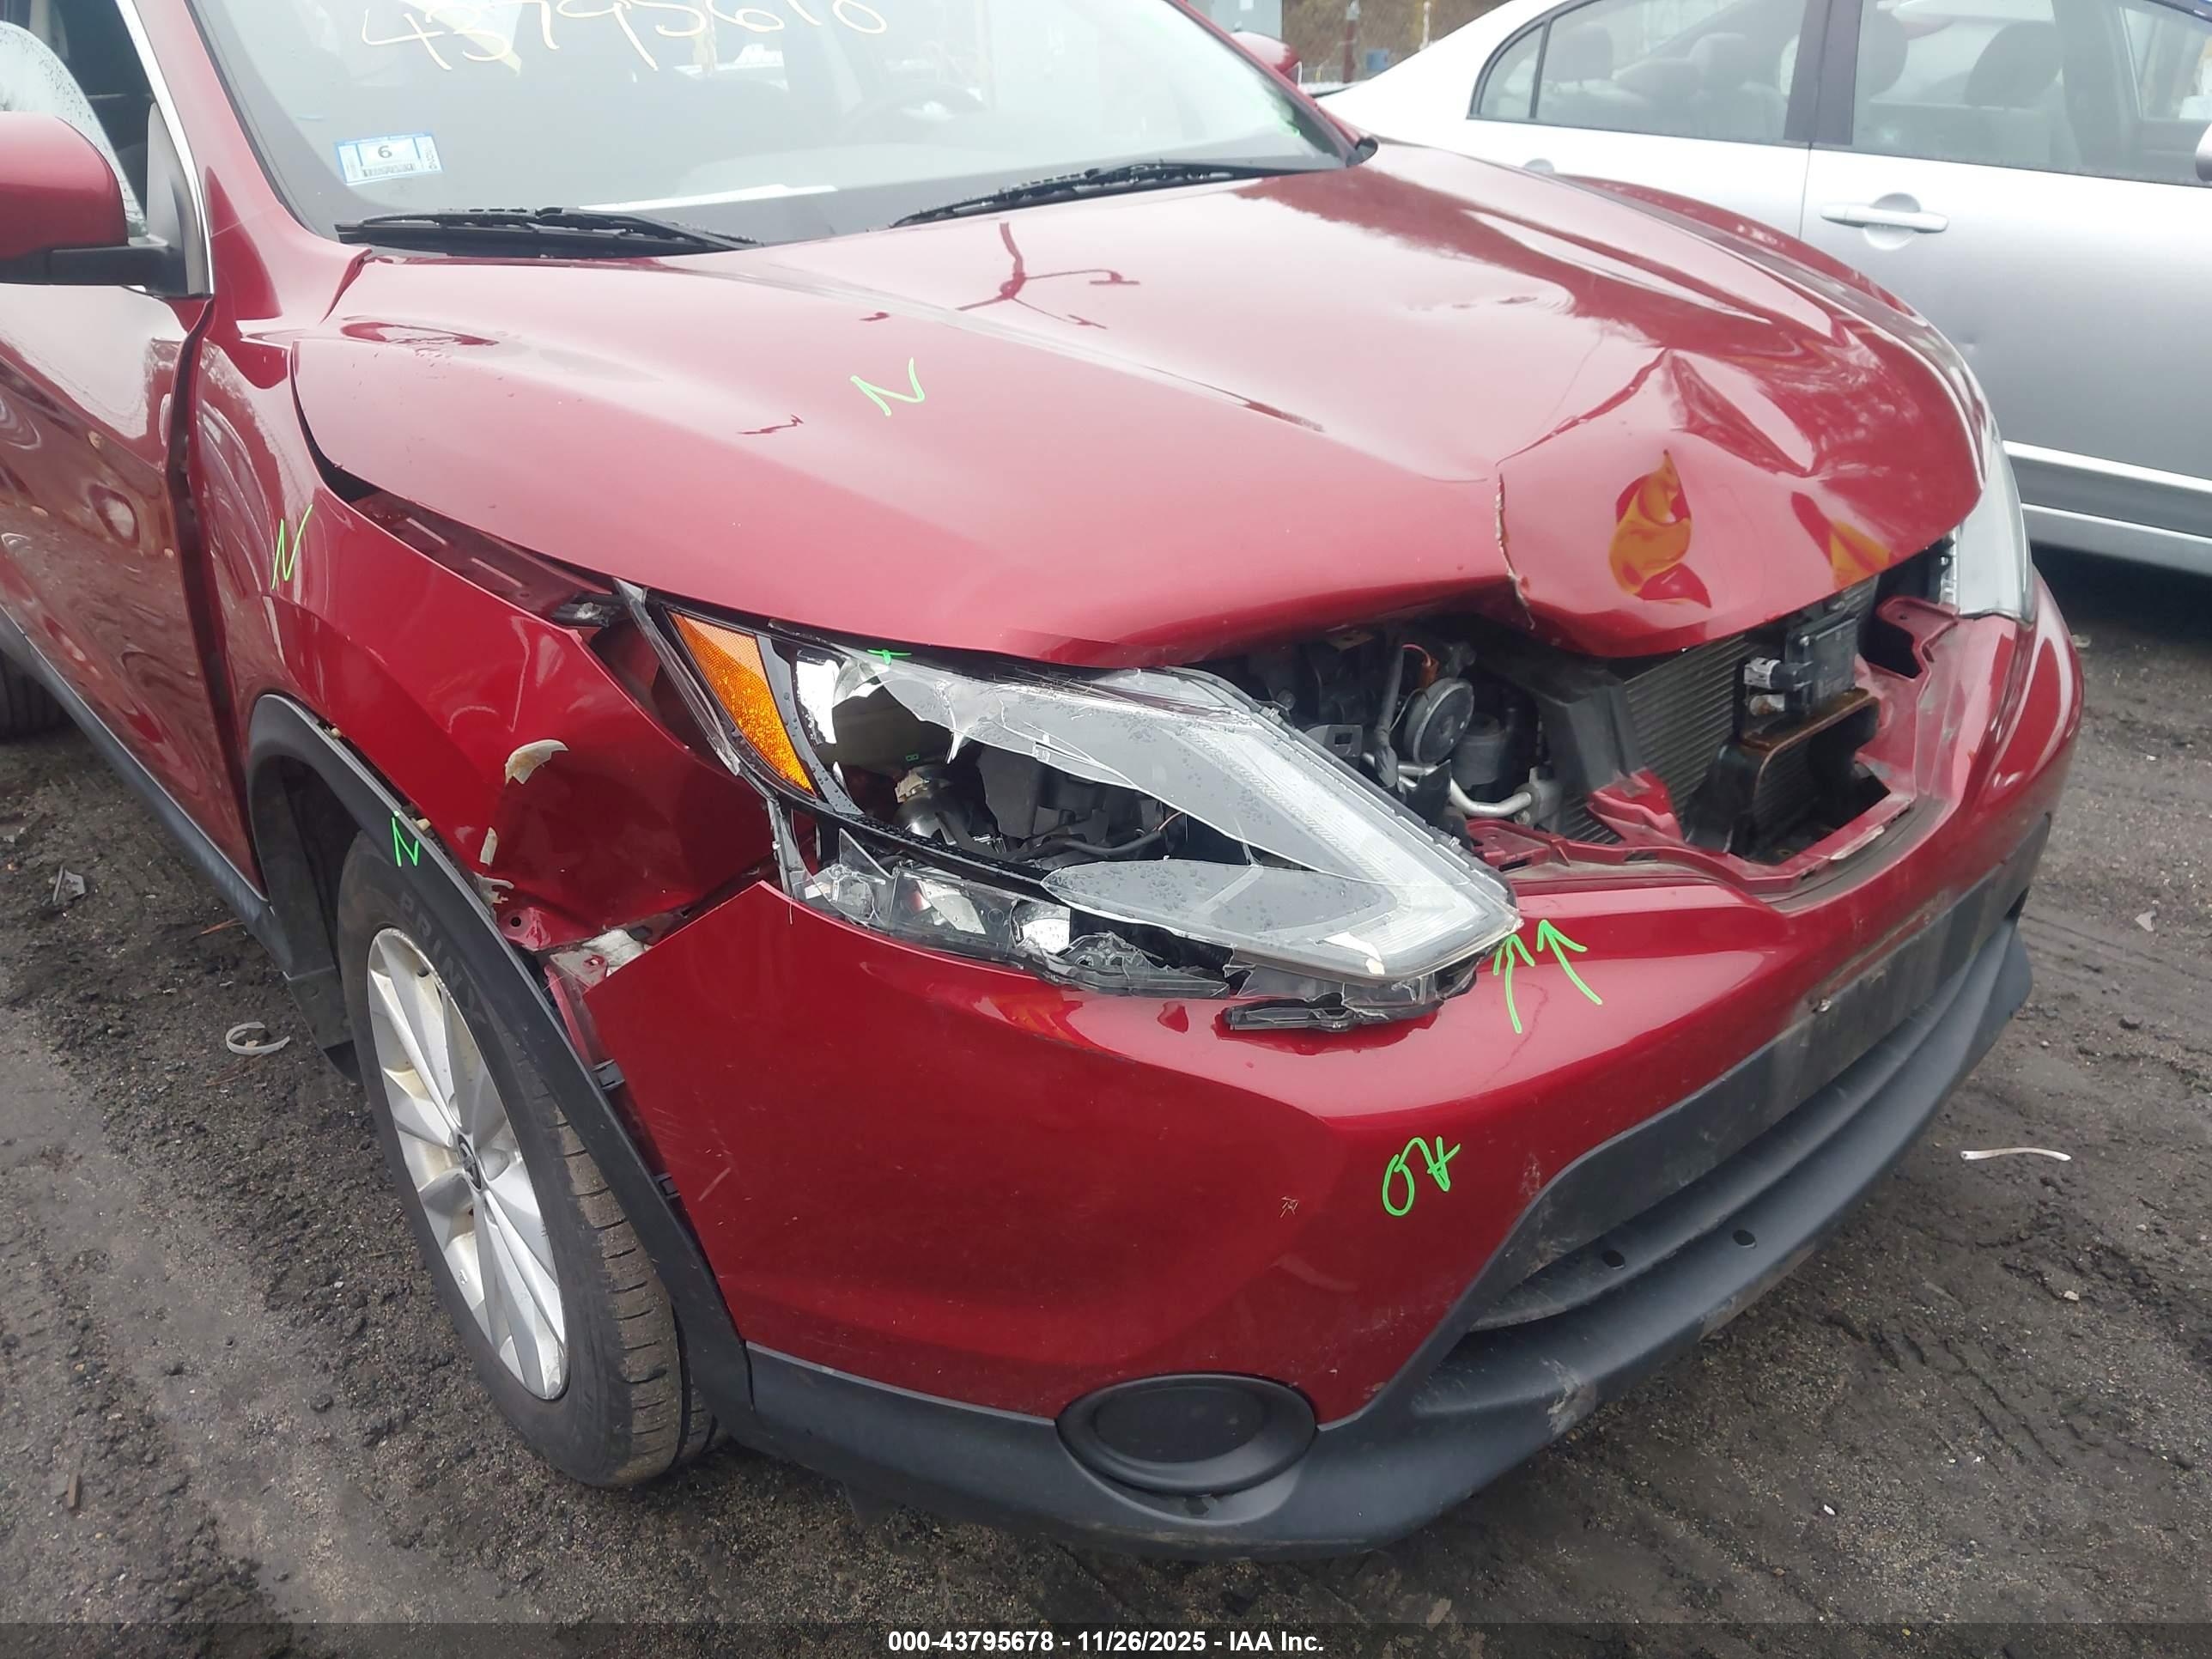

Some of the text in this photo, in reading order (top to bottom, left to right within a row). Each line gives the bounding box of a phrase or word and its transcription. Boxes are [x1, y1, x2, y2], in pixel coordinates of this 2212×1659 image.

[377, 144, 392, 159] 6
[270, 503, 313, 591] N
[392, 811, 421, 867] N
